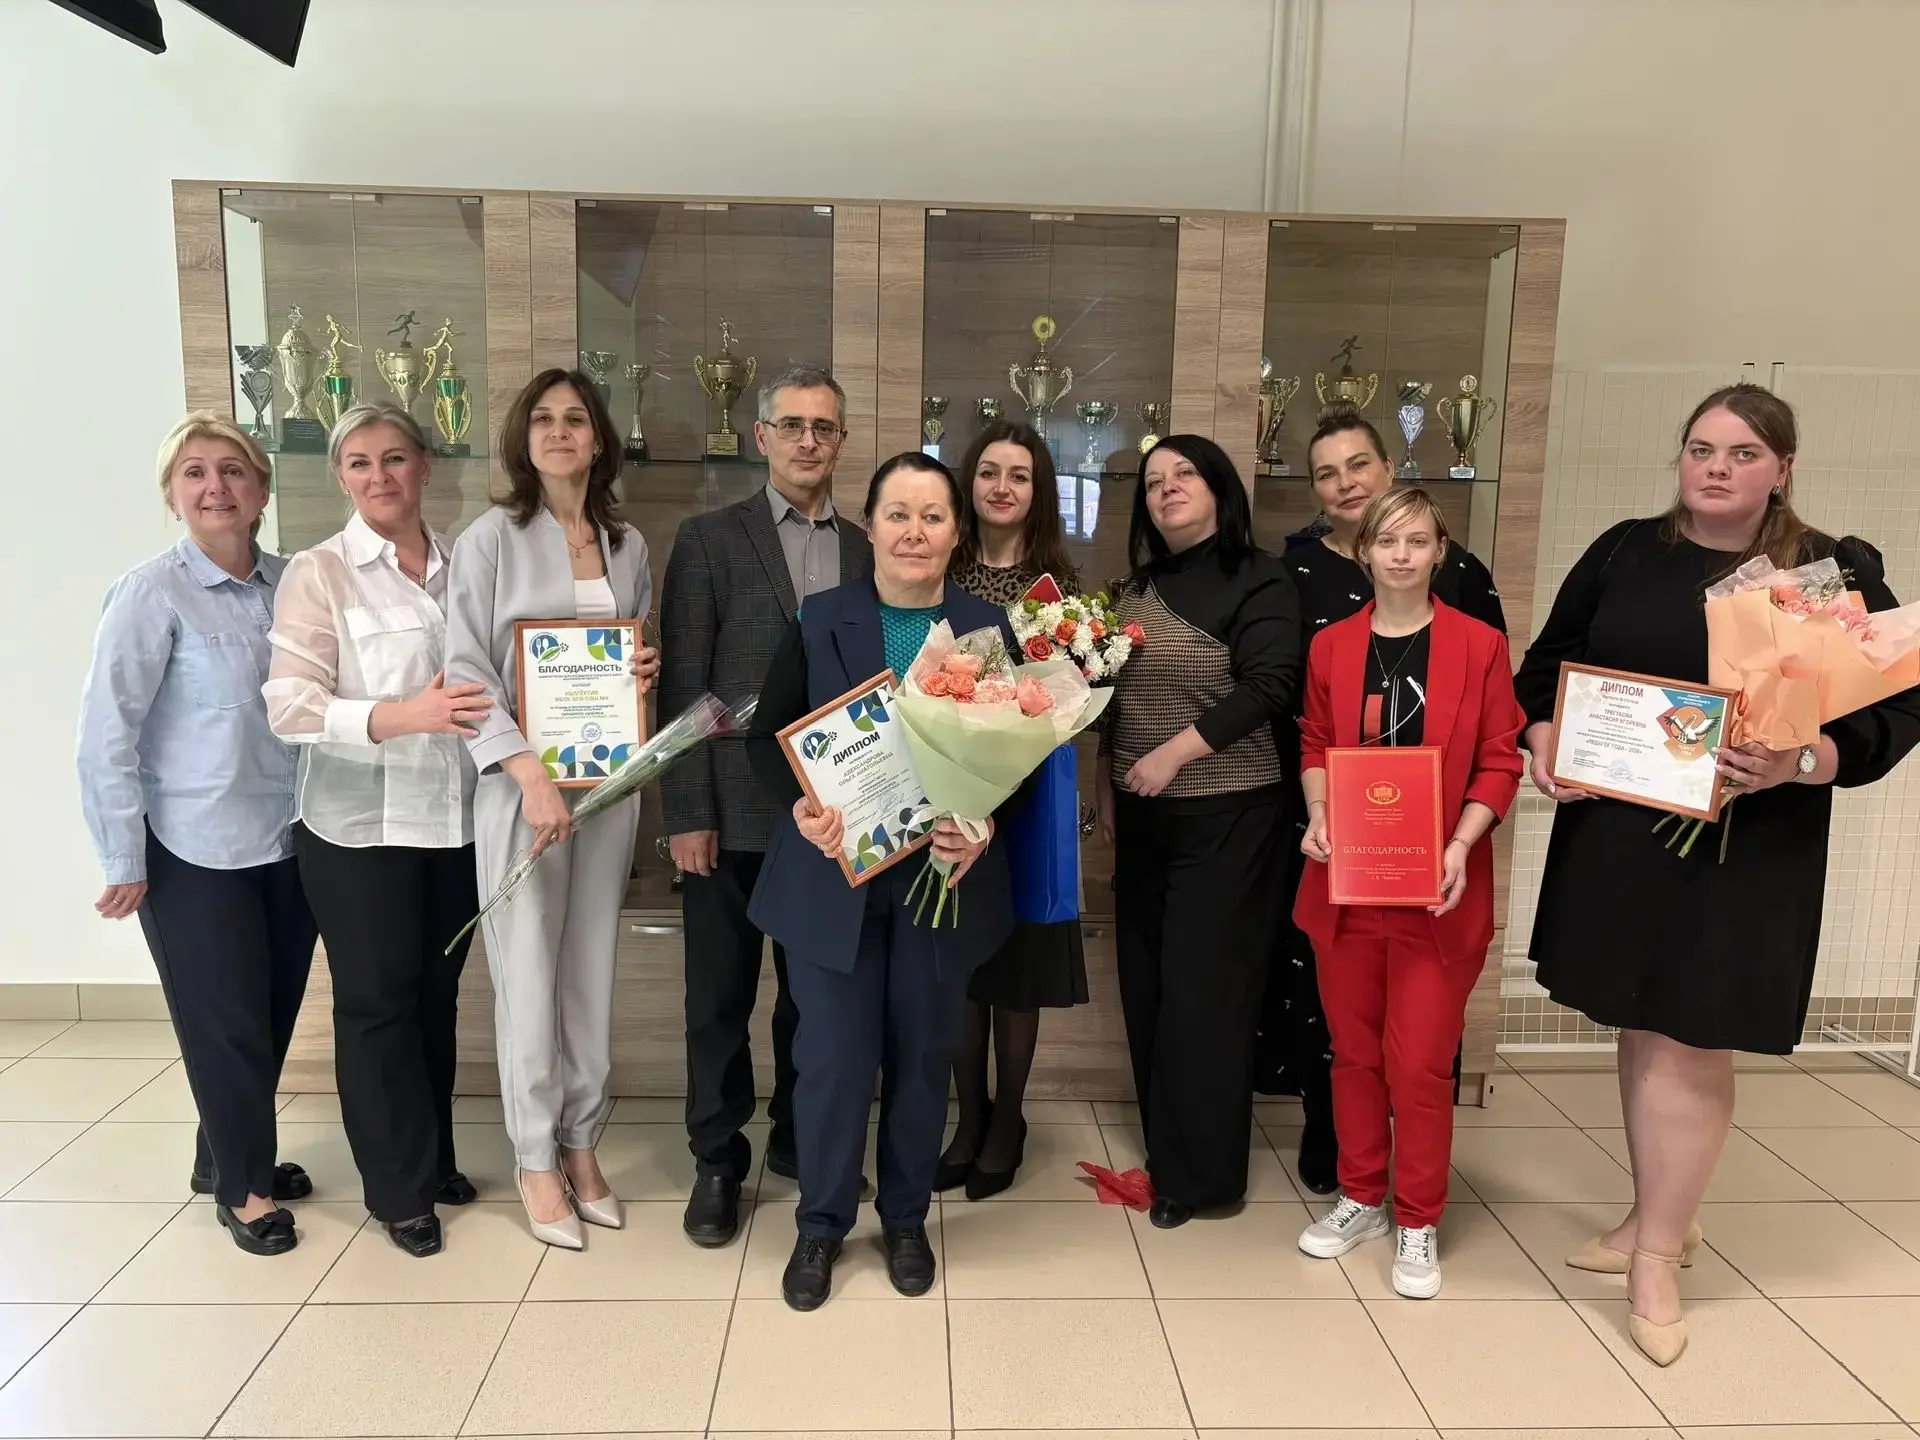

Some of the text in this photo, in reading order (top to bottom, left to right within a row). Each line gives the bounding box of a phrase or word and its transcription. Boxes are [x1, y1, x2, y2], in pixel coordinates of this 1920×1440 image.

[538, 664, 622, 674] БЛАГОДАРНОСТЬ
[1600, 681, 1644, 698] ДИПЛОМ
[832, 731, 881, 766] ДИПЛОМ
[838, 774, 856, 787] ОЛЬГА
[856, 751, 894, 777] АНАТОЛЬЕВНА
[843, 751, 885, 777] АЛЕКСАНДРОВА
[1343, 846, 1428, 855] БЛАГОДАРНОСТЬ
